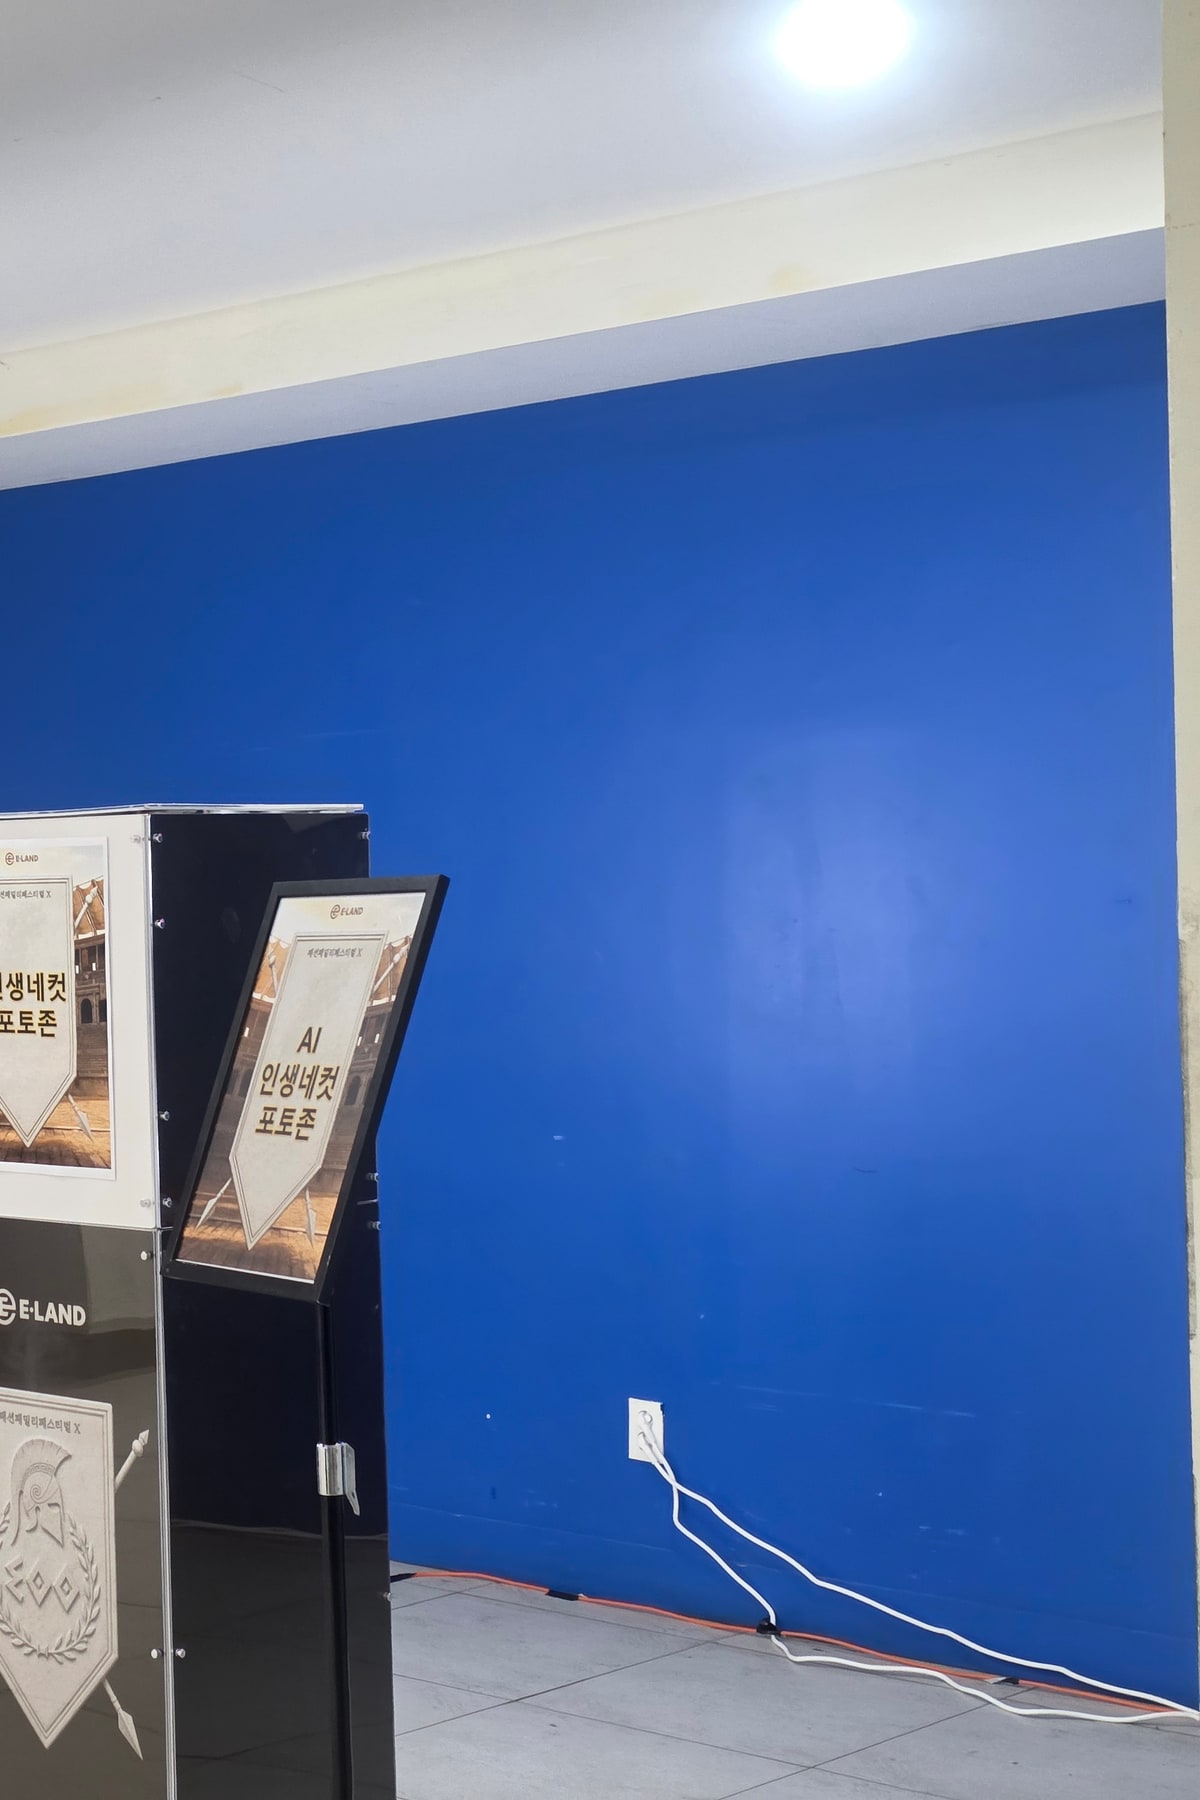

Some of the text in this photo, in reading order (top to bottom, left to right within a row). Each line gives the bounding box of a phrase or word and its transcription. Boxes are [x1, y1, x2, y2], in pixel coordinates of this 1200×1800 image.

[296, 1026, 322, 1054] AI
[259, 1063, 340, 1101] 인생네컷
[255, 1106, 317, 1141] 포토존
